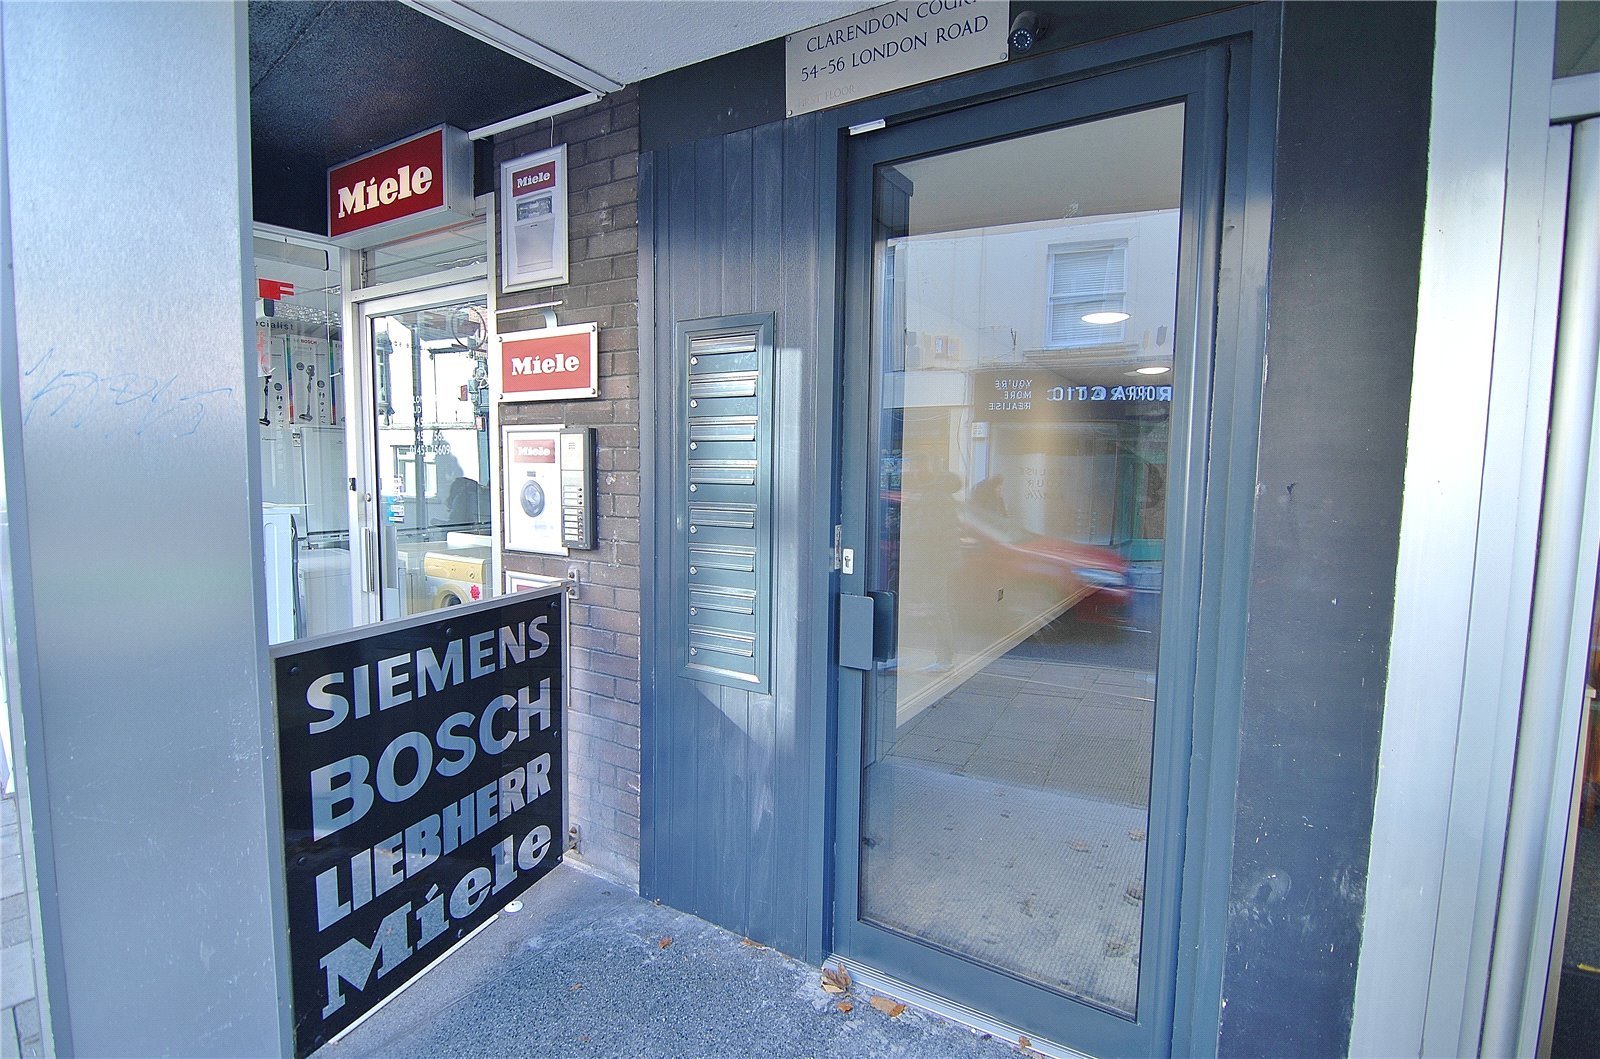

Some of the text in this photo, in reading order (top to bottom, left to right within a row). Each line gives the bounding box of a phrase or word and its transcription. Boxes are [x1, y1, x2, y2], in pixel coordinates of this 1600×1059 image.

[806, 0, 977, 53] CLARENDON COU
[852, 32, 928, 68] LONDON
[936, 15, 989, 44] ROAD
[825, 84, 855, 100] FLOOR
[337, 165, 433, 219] Miele
[516, 172, 551, 189] Miele
[510, 352, 580, 376] Miele
[518, 446, 551, 457] Miele
[306, 615, 550, 735] SIEMENS
[310, 678, 551, 842] BOSCH
[315, 752, 551, 933] LIEBHERR
[319, 824, 552, 1020] Miele
